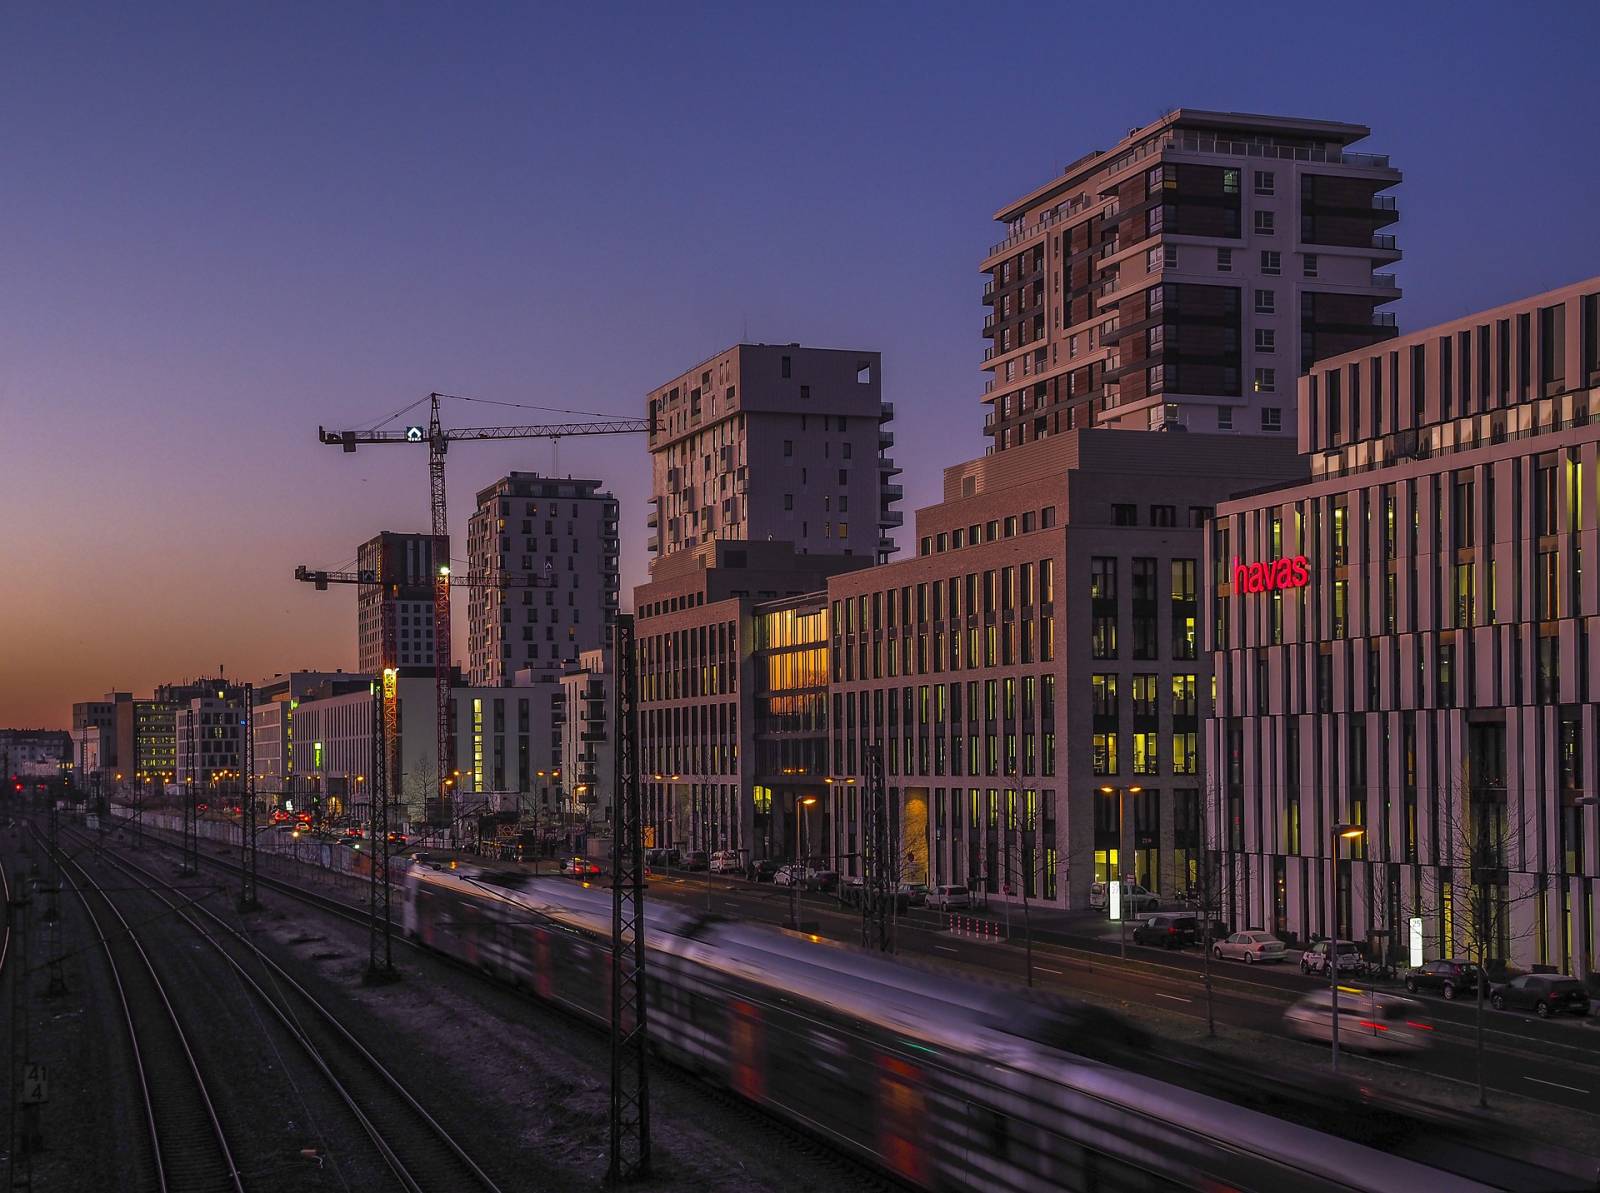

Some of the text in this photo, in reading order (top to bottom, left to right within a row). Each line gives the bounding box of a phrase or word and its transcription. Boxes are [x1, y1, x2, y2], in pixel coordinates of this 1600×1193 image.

[1232, 553, 1309, 596] havas
[28, 1066, 47, 1081] 41
[31, 1084, 42, 1100] 4
